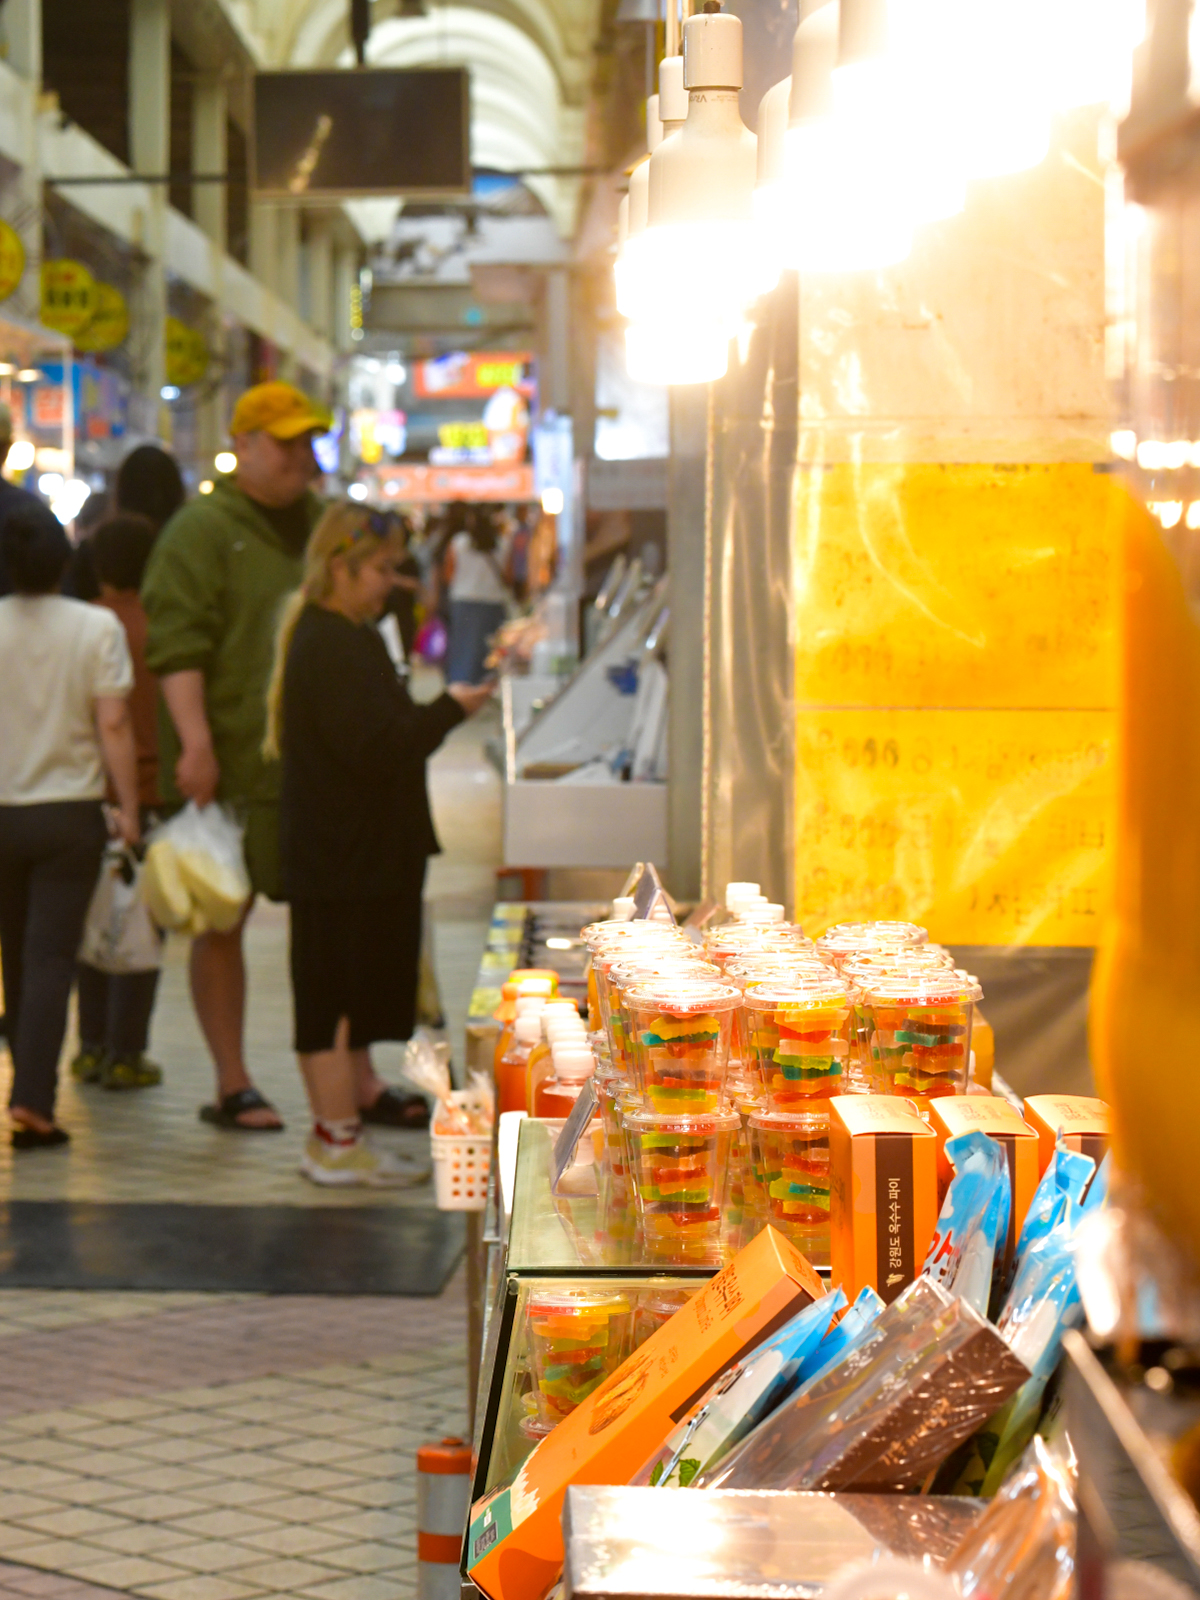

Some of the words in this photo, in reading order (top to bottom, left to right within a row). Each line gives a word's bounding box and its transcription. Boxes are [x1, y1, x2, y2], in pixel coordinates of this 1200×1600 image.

[888, 1177, 901, 1200] 파이
[888, 1201, 902, 1234] 옥수수
[889, 1236, 902, 1268] 강원도
